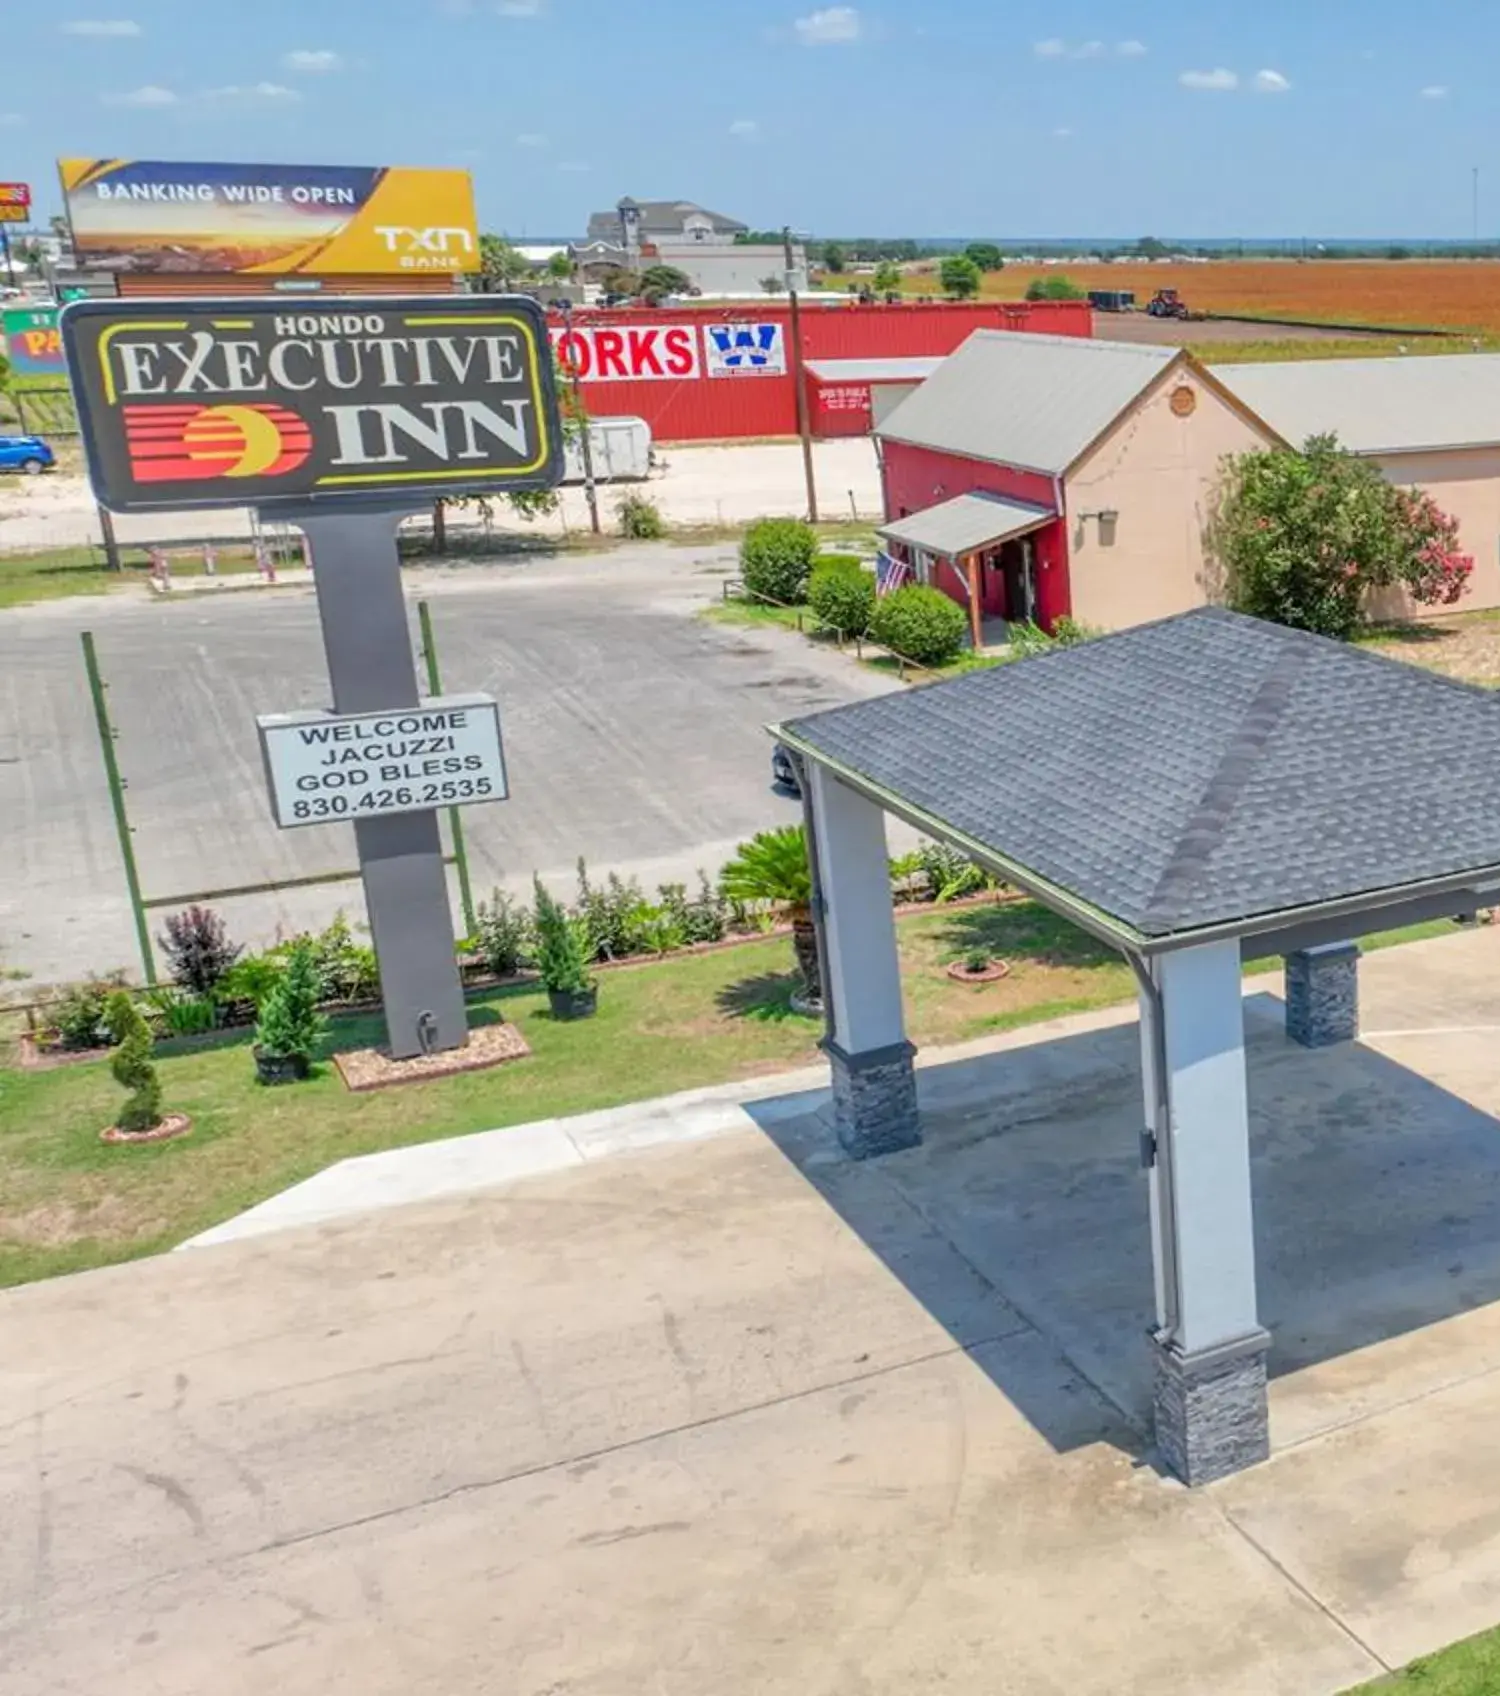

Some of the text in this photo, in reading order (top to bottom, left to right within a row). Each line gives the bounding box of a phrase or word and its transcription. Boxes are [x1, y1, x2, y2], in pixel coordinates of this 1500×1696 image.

[96, 182, 355, 203] BANKING WIDE OPEN
[400, 256, 461, 268] BANK
[274, 315, 385, 336] HONDO
[113, 331, 524, 395] EXECUTIVE
[322, 399, 530, 465] INN
[299, 712, 468, 745] WELCOME
[320, 735, 455, 766] JACUZZI
[296, 755, 483, 791] GOD BLESS
[293, 776, 493, 818] 830.426.2535
